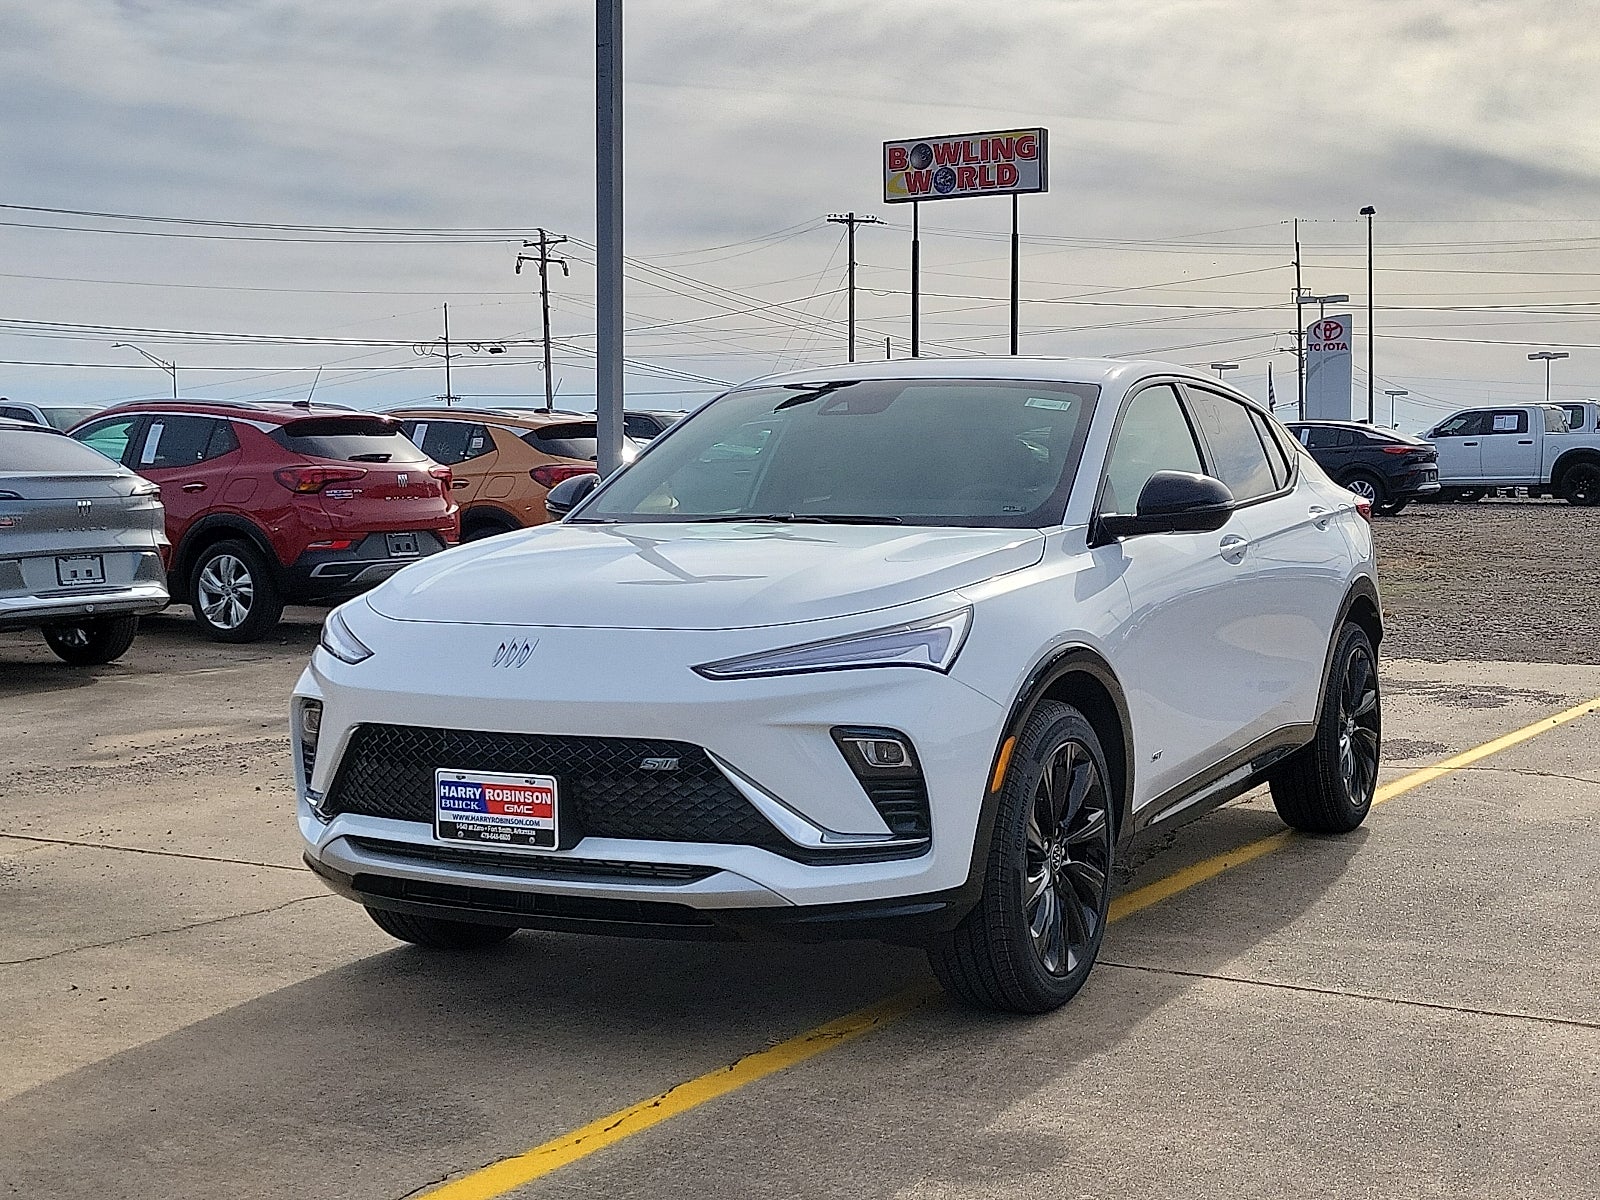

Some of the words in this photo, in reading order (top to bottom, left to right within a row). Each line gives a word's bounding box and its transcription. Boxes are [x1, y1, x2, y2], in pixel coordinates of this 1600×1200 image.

[888, 135, 1038, 172] BOWLING
[904, 163, 1019, 195] WORLD
[1308, 342, 1349, 352] TOYOTA
[639, 757, 679, 771] ST
[440, 785, 482, 799] HARRY
[485, 788, 551, 804] ROBINSON
[441, 800, 481, 810] BUICK
[504, 804, 534, 814] GMC
[452, 813, 540, 827] WWW.HARRYROBINSON.COM
